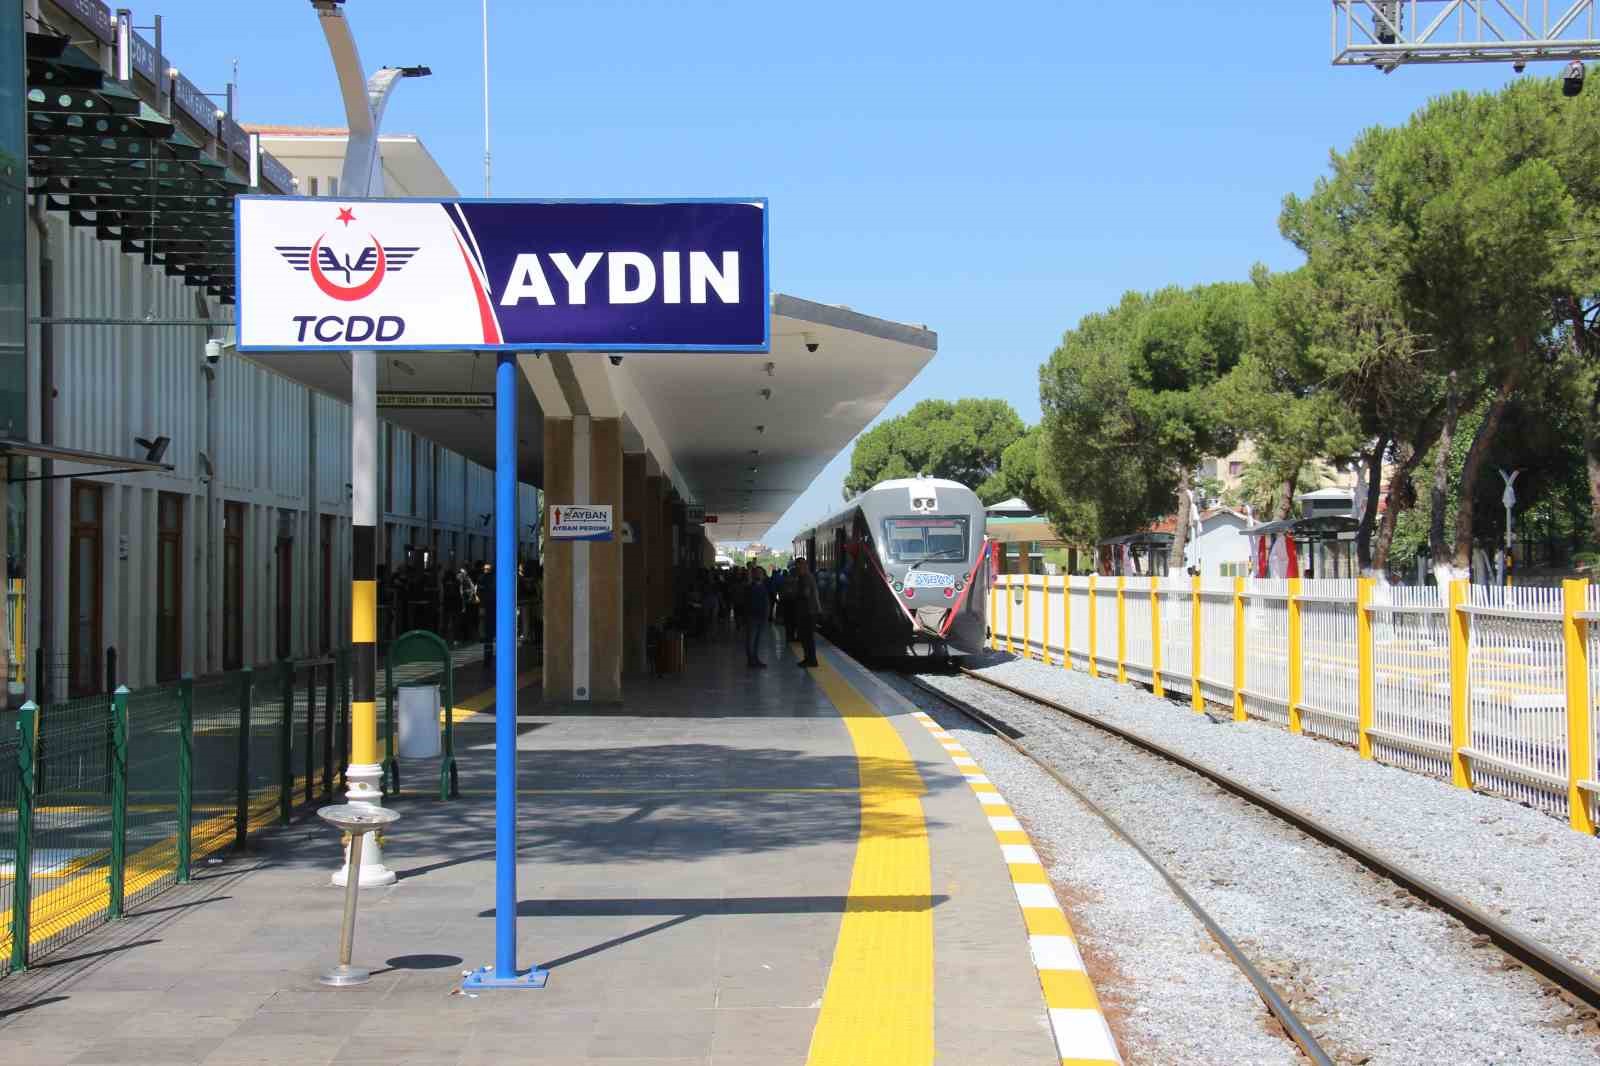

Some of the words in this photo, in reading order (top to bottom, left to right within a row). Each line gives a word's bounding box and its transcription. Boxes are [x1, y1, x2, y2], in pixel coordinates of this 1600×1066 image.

[499, 250, 740, 306] AYDIN
[292, 315, 406, 342] TCDD
[572, 511, 607, 519] AYBAN
